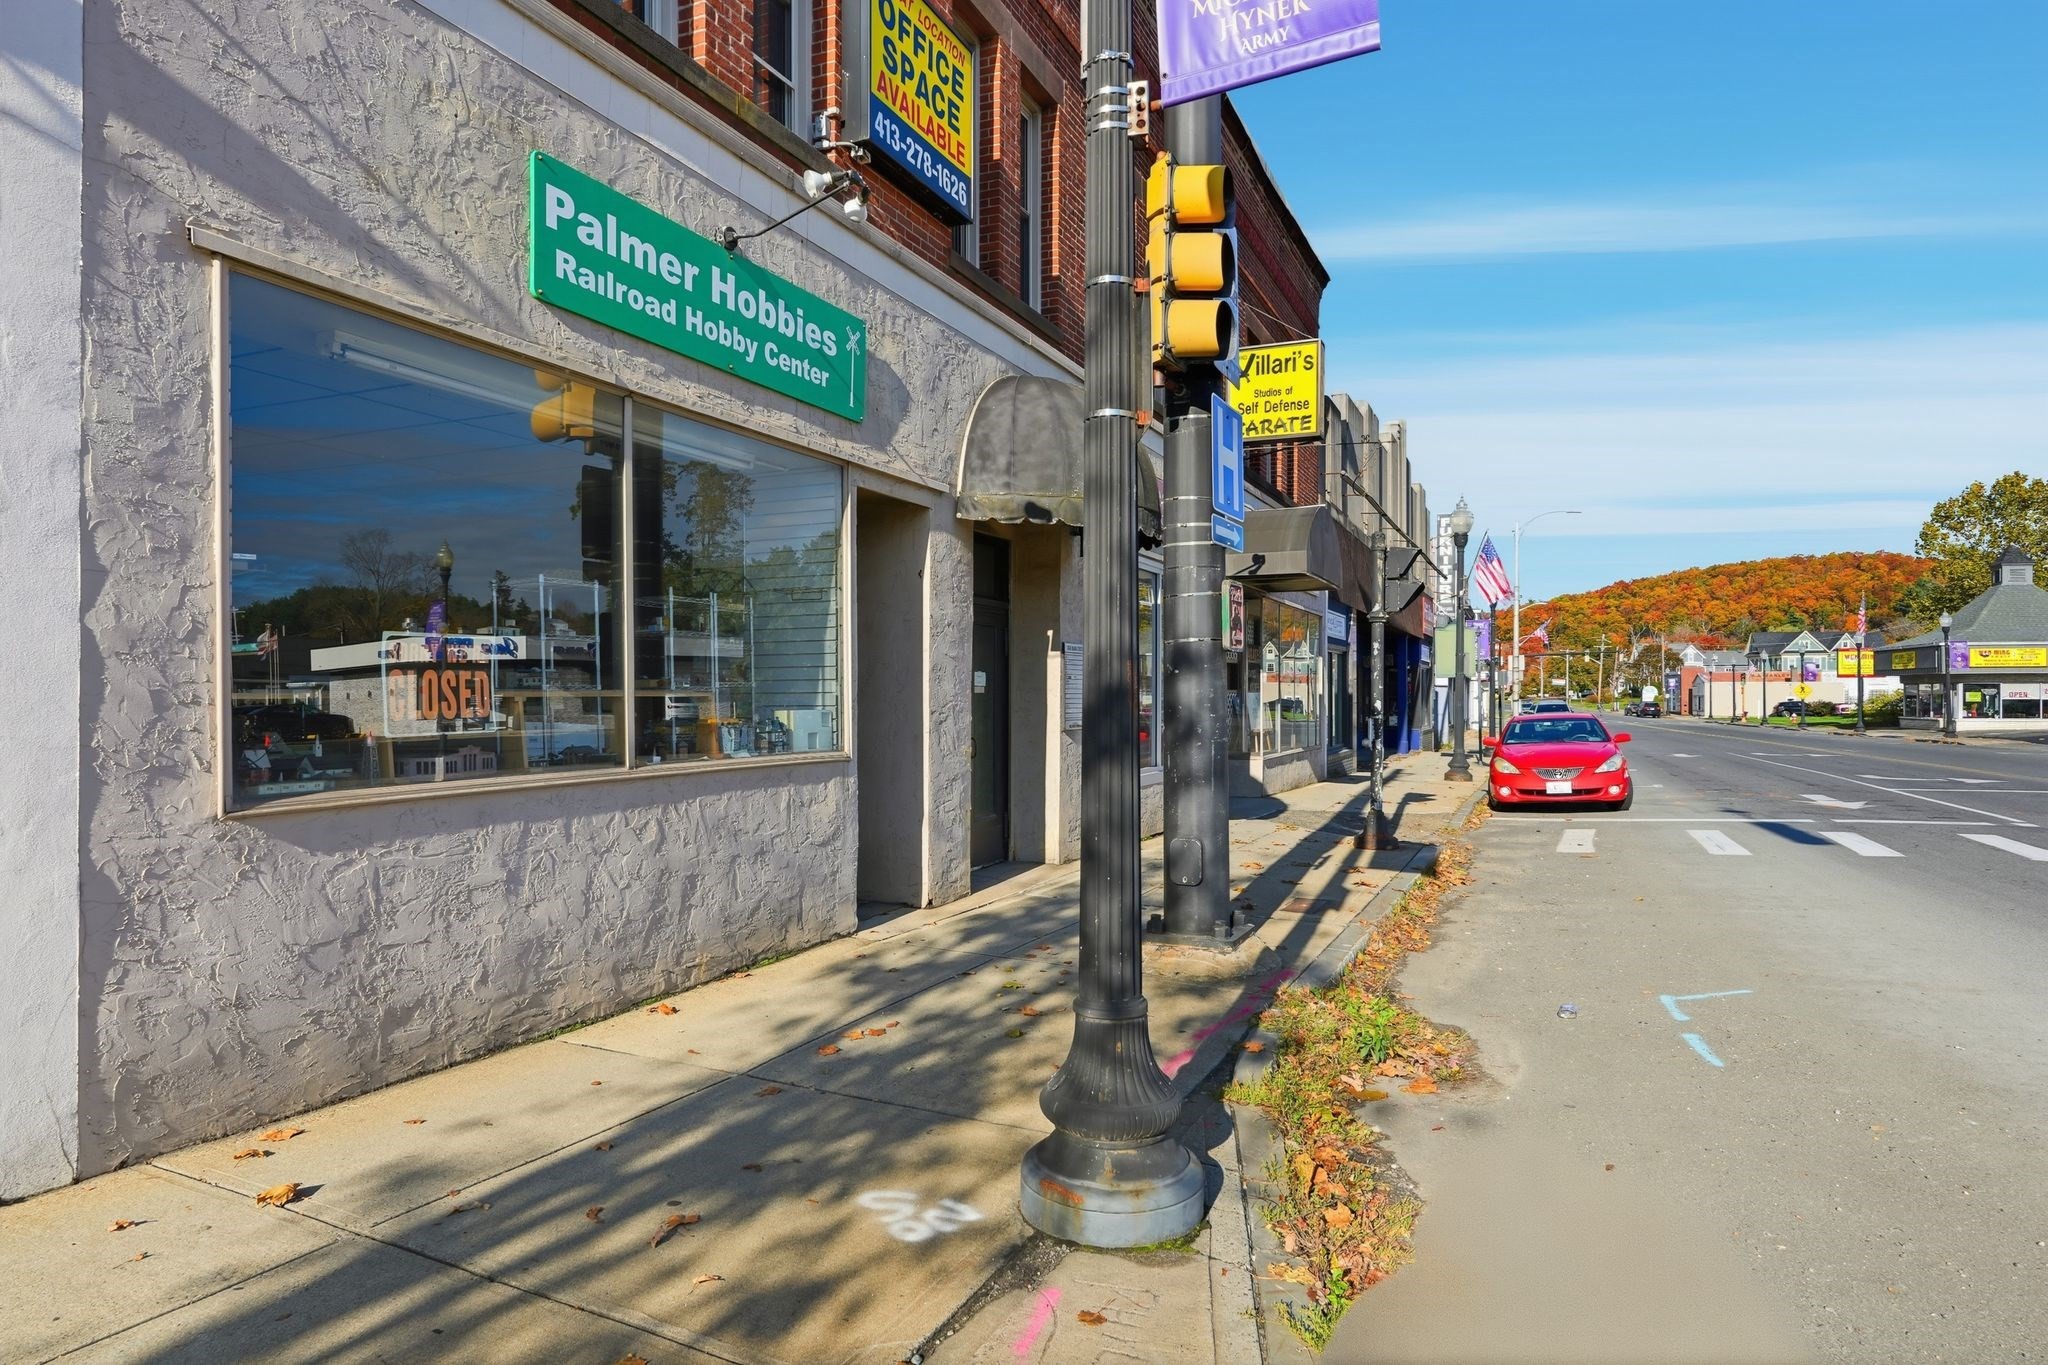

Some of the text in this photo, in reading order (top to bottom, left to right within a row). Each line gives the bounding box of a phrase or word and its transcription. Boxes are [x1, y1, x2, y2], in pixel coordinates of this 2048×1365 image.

[878, 0, 965, 103] OFFICE
[918, 9, 966, 67] LOCATION
[1240, 25, 1291, 54] ARMY
[876, 70, 966, 168] AVAILABLE
[883, 35, 961, 136] SPACE
[875, 112, 967, 206] 413-278-1626
[545, 182, 837, 356] Palmer Hobbies
[555, 248, 830, 388] Railroad Hobby Center
[1237, 400, 1310, 415] Self Defense
[1242, 414, 1312, 436] ARATE
[1254, 386, 1293, 399] Studios of
[1217, 405, 1239, 513] H
[388, 668, 491, 721] CLOSED
